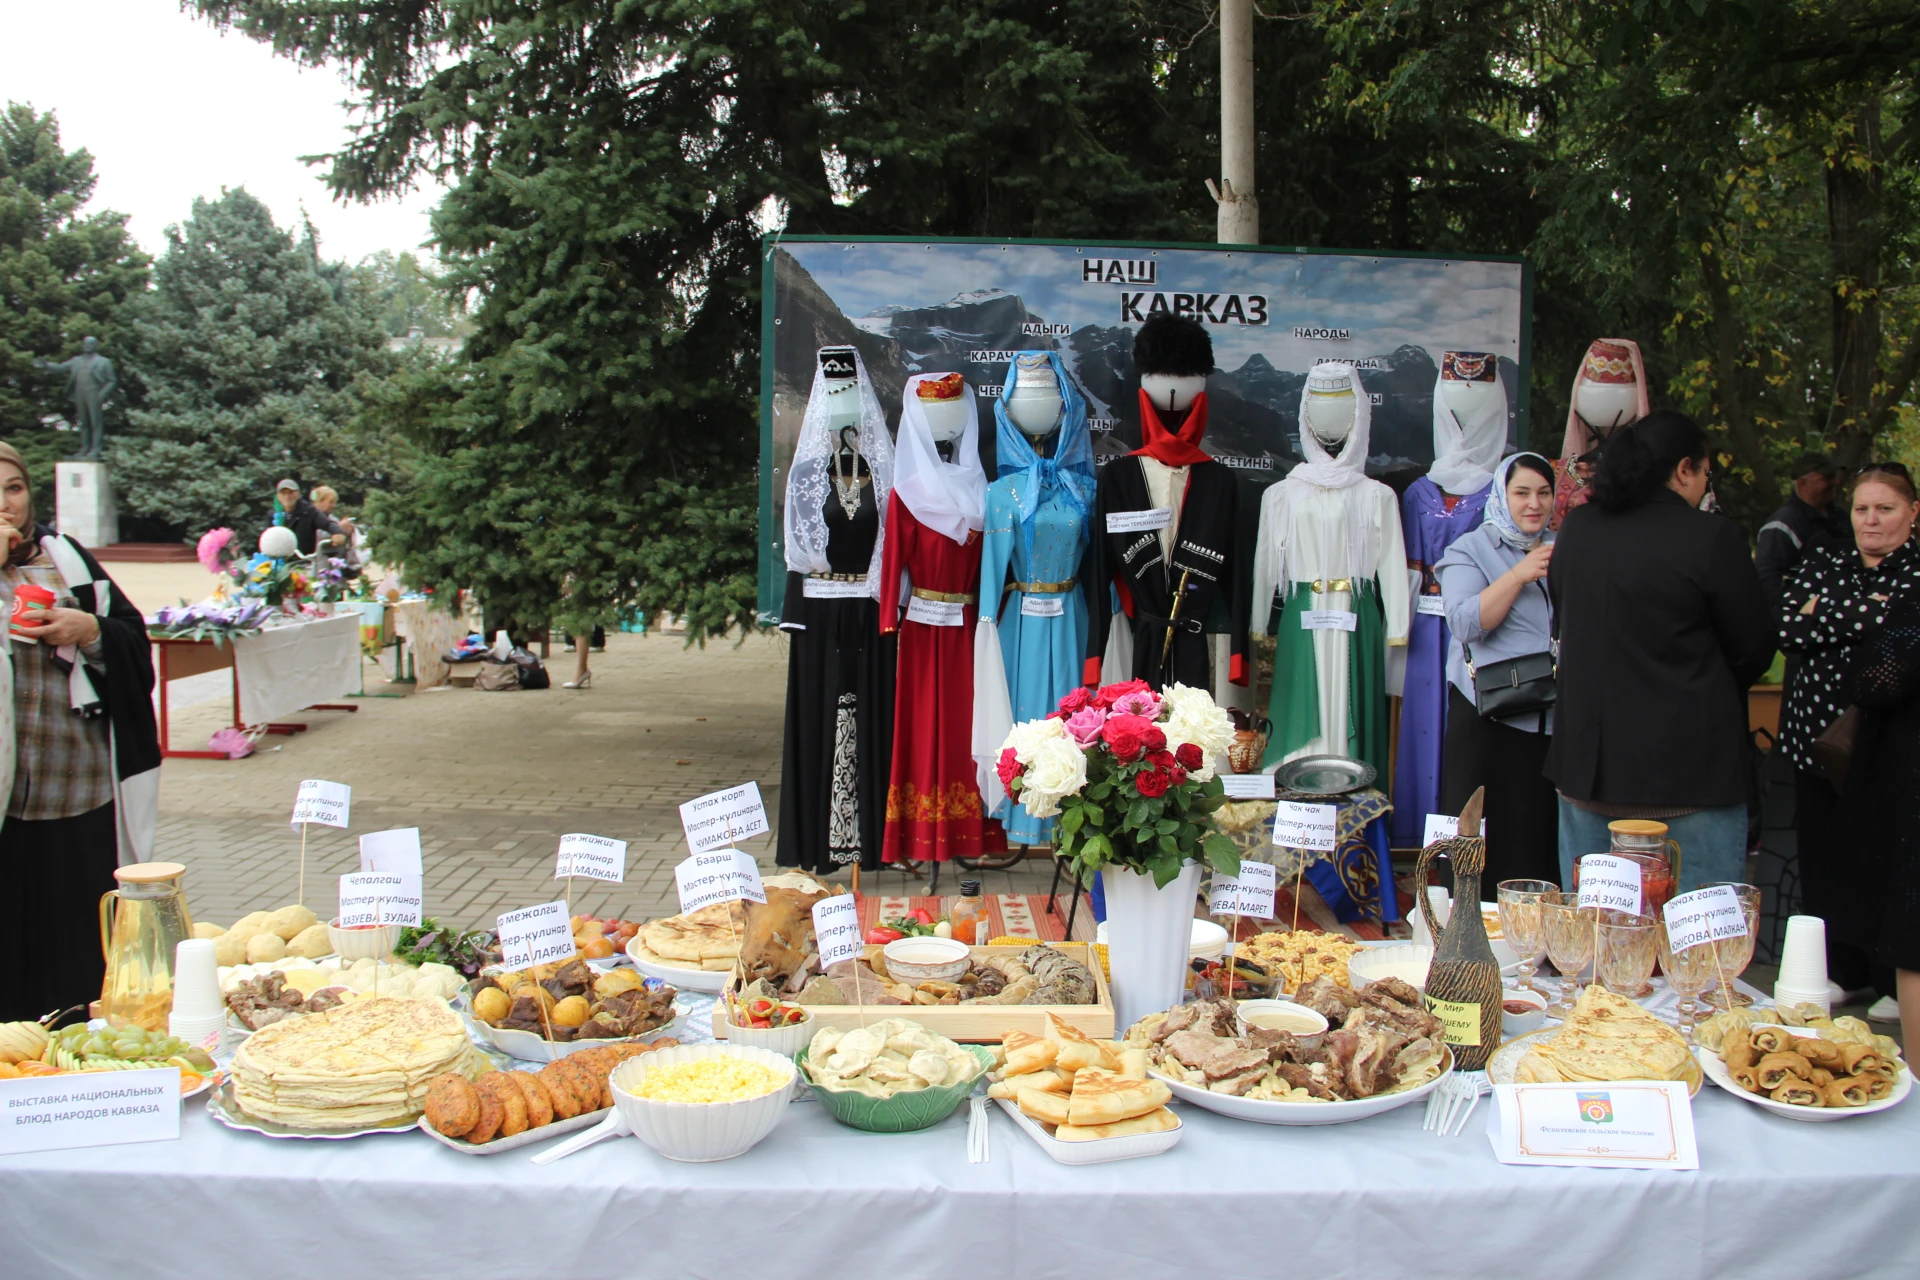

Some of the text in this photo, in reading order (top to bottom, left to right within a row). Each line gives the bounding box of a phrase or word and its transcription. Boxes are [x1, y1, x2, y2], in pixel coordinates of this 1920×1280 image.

[1083, 259, 1156, 283] НАШ
[1121, 293, 1268, 325] КАВКАЗ
[1023, 324, 1070, 336] АДЫГИ
[1294, 328, 1350, 340] НАРОДЫ
[971, 351, 1014, 361] КАРАЧ
[980, 386, 1003, 396] ЧЕР
[1213, 455, 1273, 469] ОСЕТИНЫ
[692, 789, 746, 812] Устах корт
[1289, 802, 1321, 814] Чак чак
[314, 811, 338, 822] ХЕДА
[1276, 817, 1335, 832] Мастер-кулинар
[696, 819, 762, 848] ЧУМАКОВА АСЕТ
[1274, 833, 1316, 846] ЧУМАКОВА
[578, 835, 615, 848] жижиг
[696, 853, 732, 866] Баарш
[1581, 859, 1618, 869] нгалш
[574, 865, 619, 880] МАЛКАН
[1241, 866, 1273, 877] галнаш
[349, 876, 402, 886] Чепалгаш
[683, 871, 753, 893] Мастер-кулинар
[1697, 888, 1728, 900] галнаш
[1239, 902, 1268, 914] МАРЕТ
[1579, 894, 1634, 909] ЕВА ЗУЛАЙ
[342, 912, 417, 926] ХАЗУЕВА ЗУЛАЙ
[1669, 906, 1737, 931] Мастер-кулинар
[501, 924, 567, 947] тер-кулинар
[1671, 922, 1746, 952] ЮНУСОВА МАЛКАН
[533, 943, 572, 961] ЛАРИСА
[1443, 1003, 1465, 1013] МИР
[1443, 1018, 1472, 1029] ШЕМУ
[1442, 1033, 1464, 1042] ОМУ
[8, 1086, 164, 1108] ВЫСТАВКА НАЦИОНАЛЬНЫХ
[16, 1104, 160, 1125] БЛЮД НАРОДОВ КАВКАЗА
[1588, 1127, 1620, 1135] сельское
